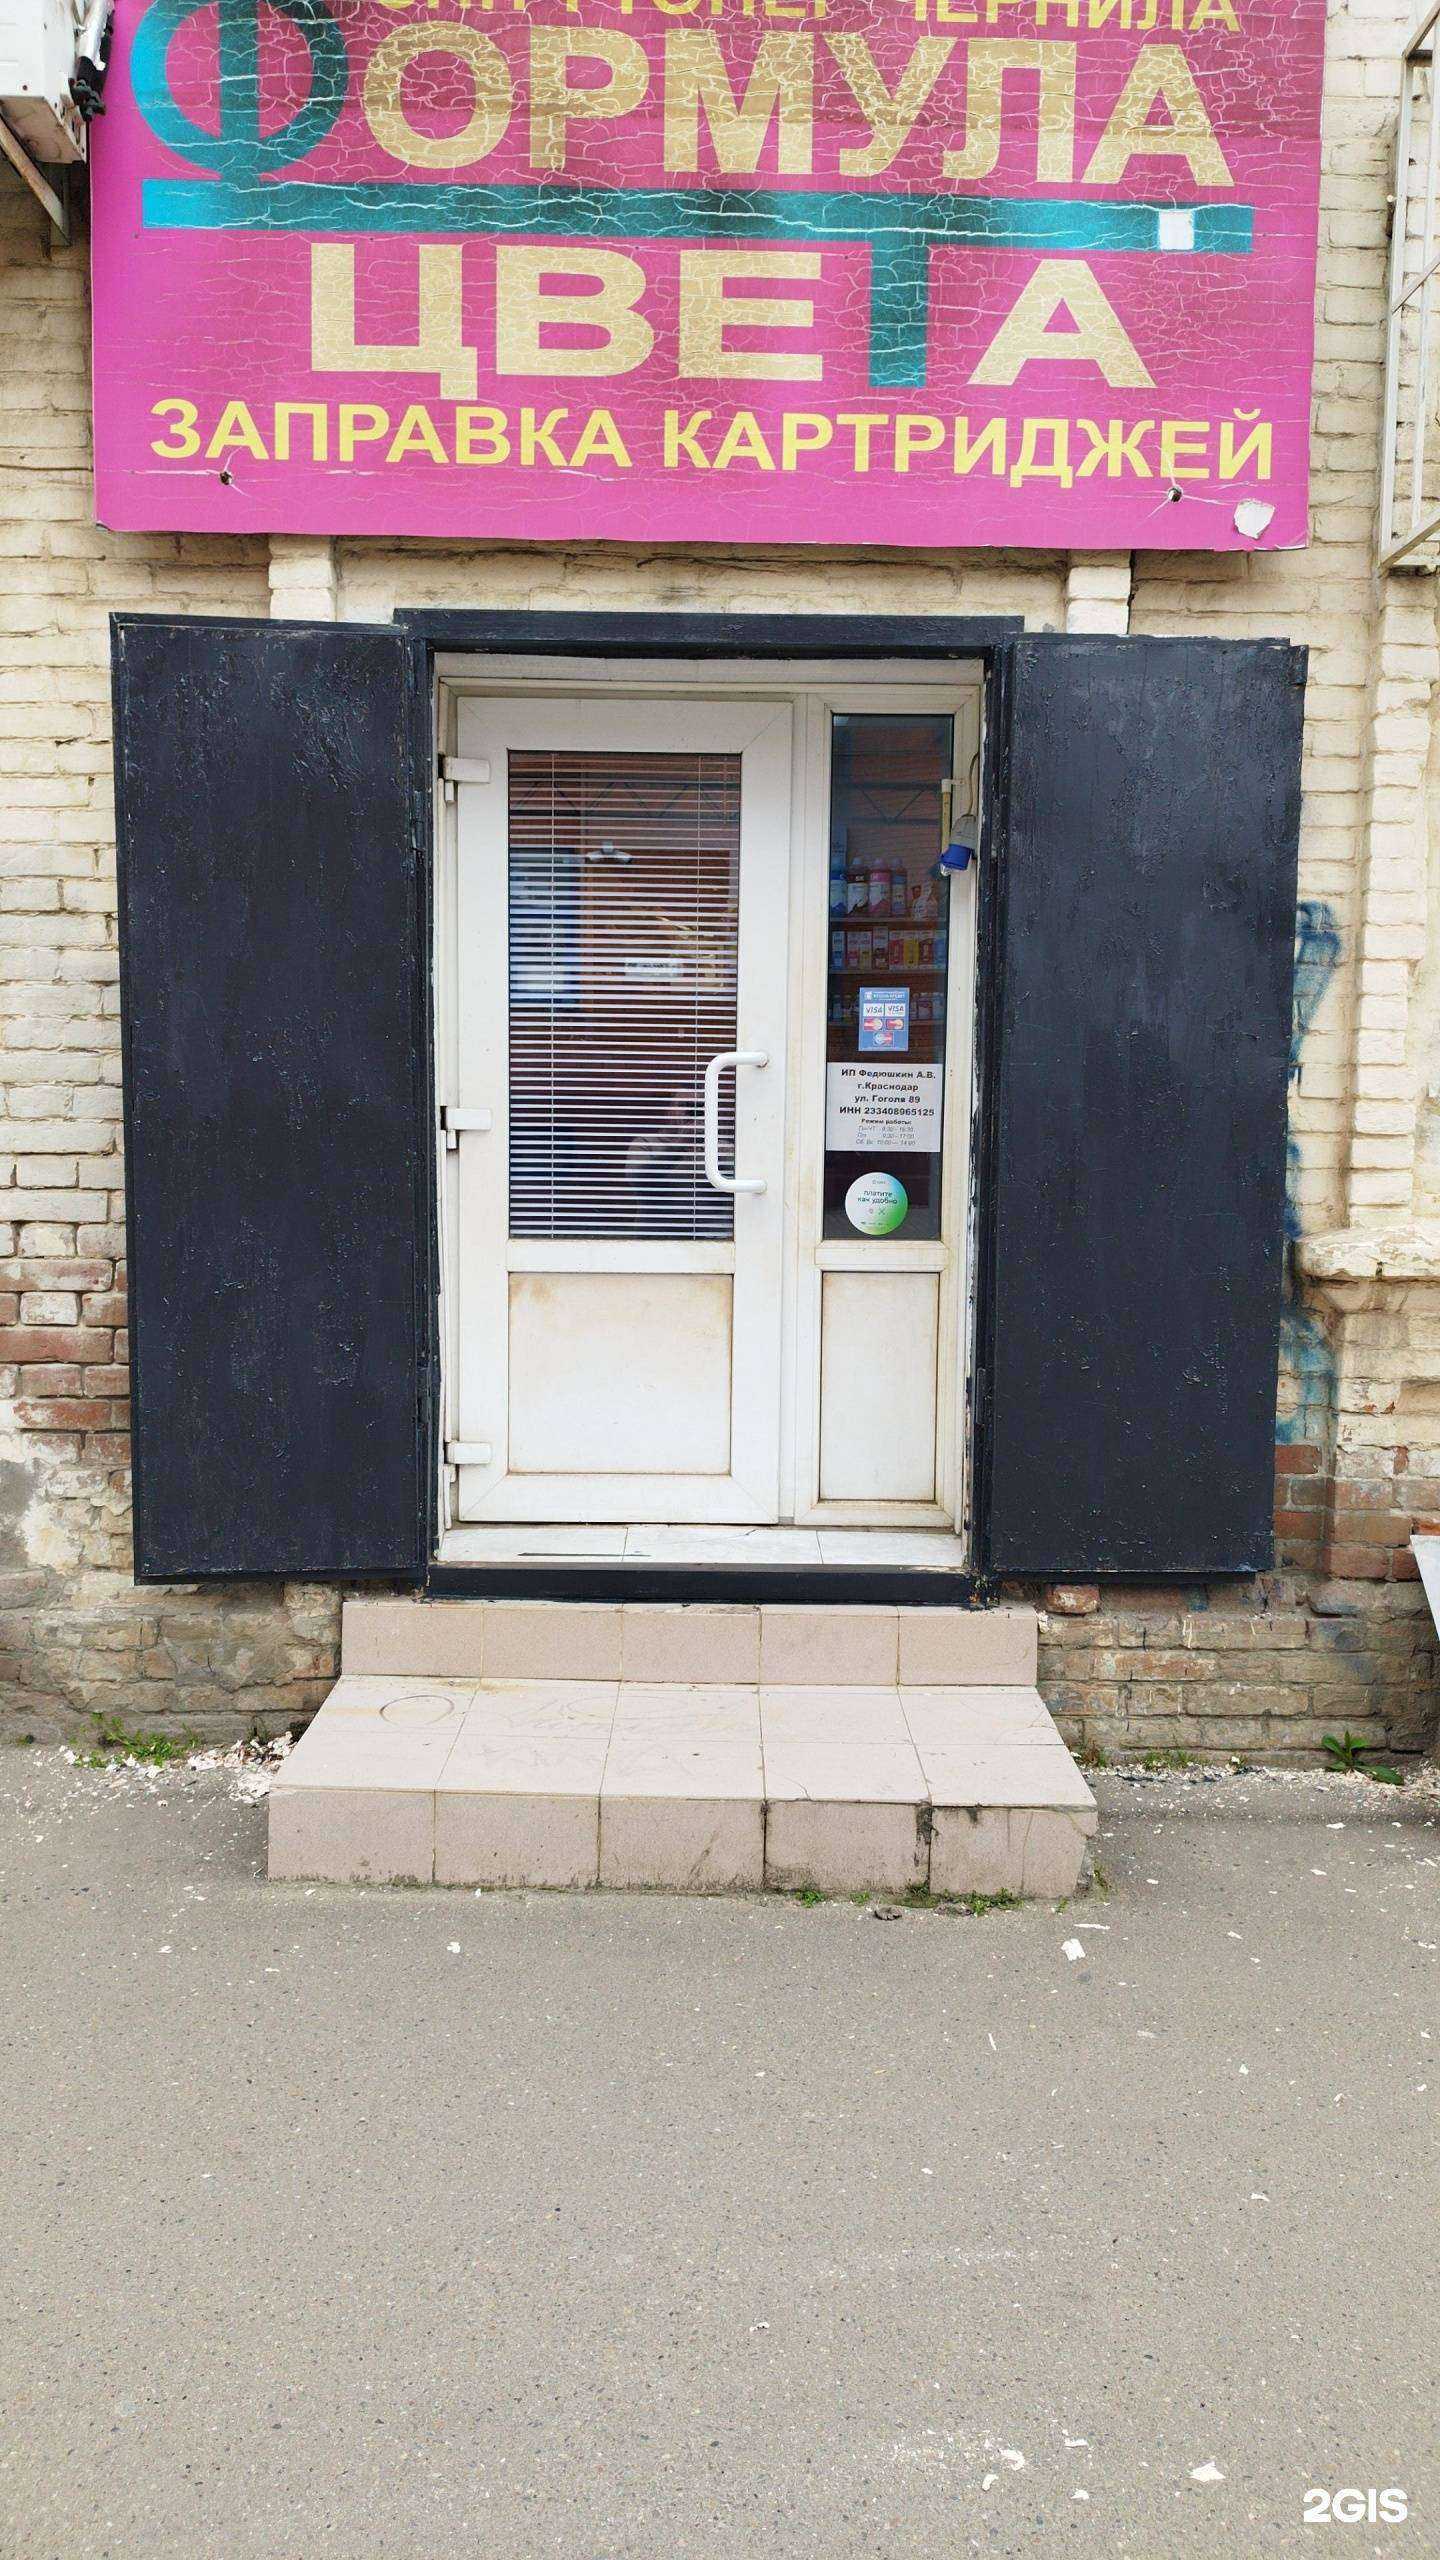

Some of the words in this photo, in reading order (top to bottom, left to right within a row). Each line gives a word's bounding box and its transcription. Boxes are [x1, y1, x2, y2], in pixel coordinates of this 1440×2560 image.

[130, 0, 1235, 187] ФОРМУЛА
[310, 196, 1157, 401] ЦВЕТА
[150, 399, 632, 469] ЗАПРАВКА
[663, 408, 1273, 489] КАРТРИДЖЕЙ
[841, 1069, 856, 1077] ИП
[916, 1071, 936, 1079] А.В.
[857, 1082, 919, 1092] г.Краснодар
[854, 1095, 869, 1103] ул.
[872, 1095, 906, 1103] Гоголя
[839, 1107, 861, 1115] ИНН
